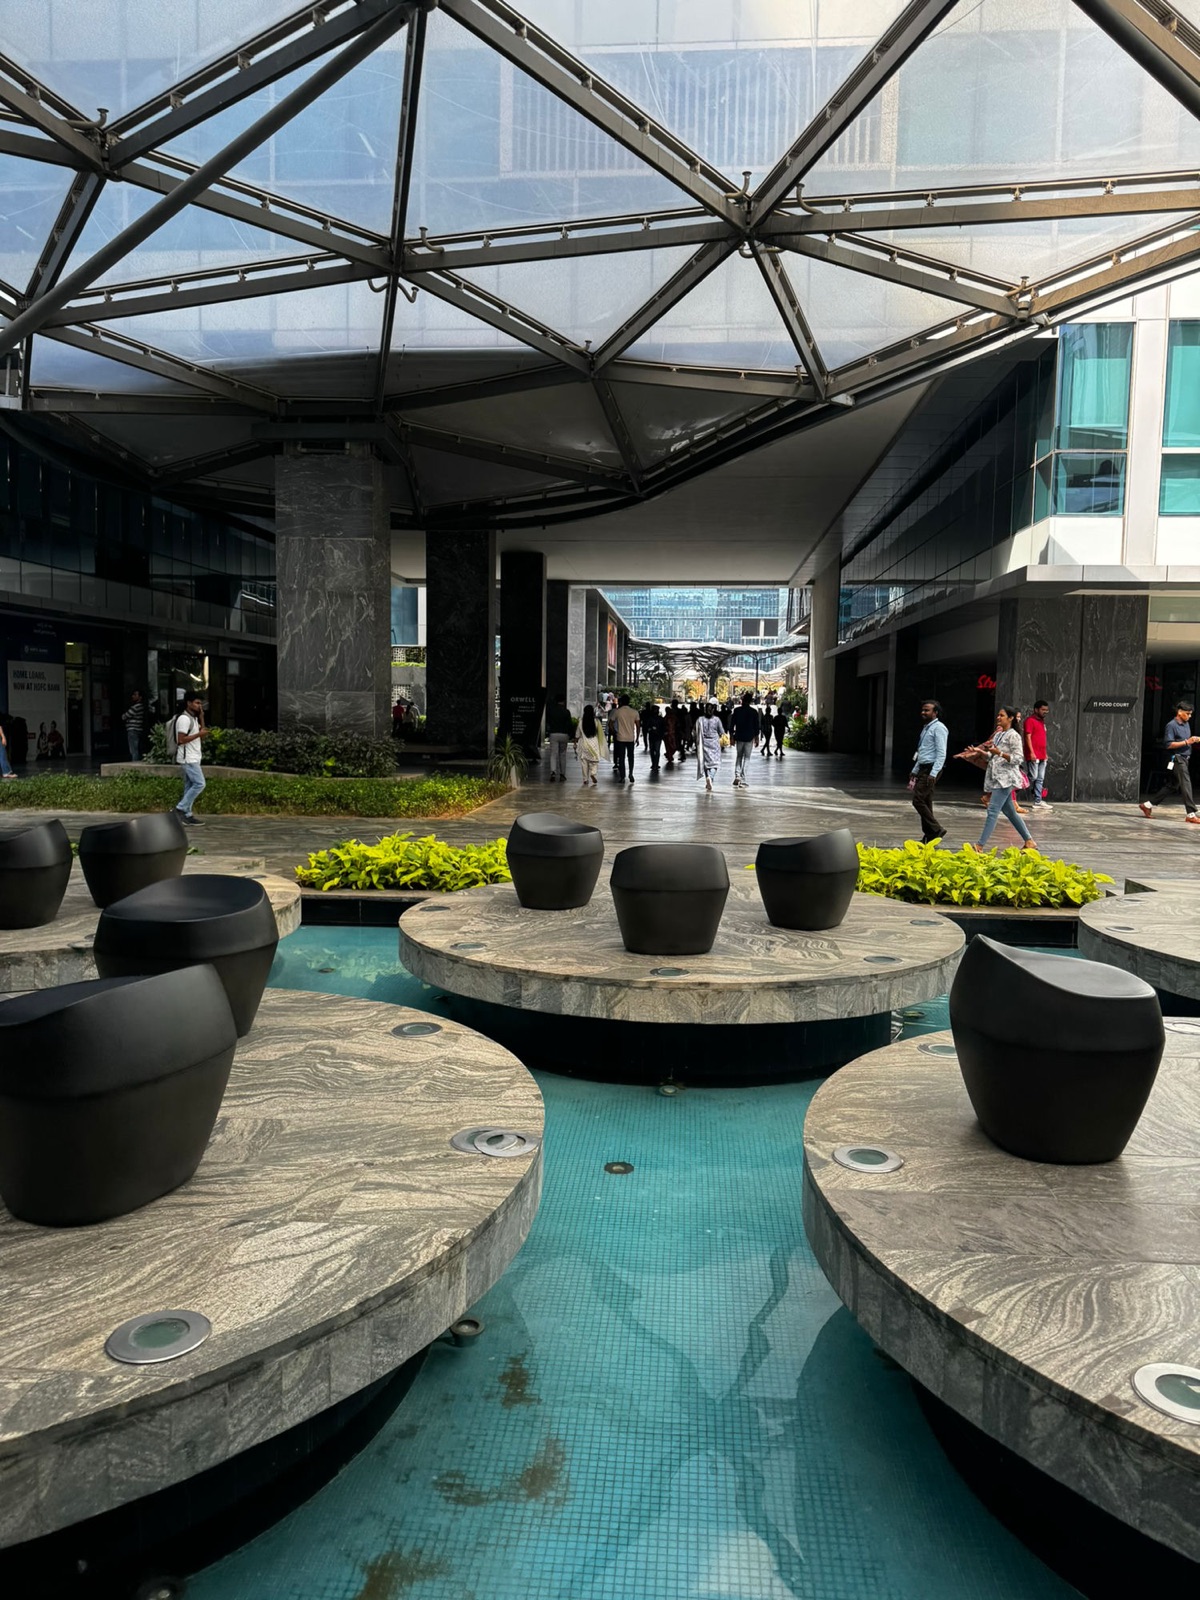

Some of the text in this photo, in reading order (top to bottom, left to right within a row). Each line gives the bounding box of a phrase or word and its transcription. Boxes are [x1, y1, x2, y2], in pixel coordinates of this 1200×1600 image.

[13, 670, 46, 681] HOME LOANS,
[13, 682, 60, 692] NOW AT HDFC BANK
